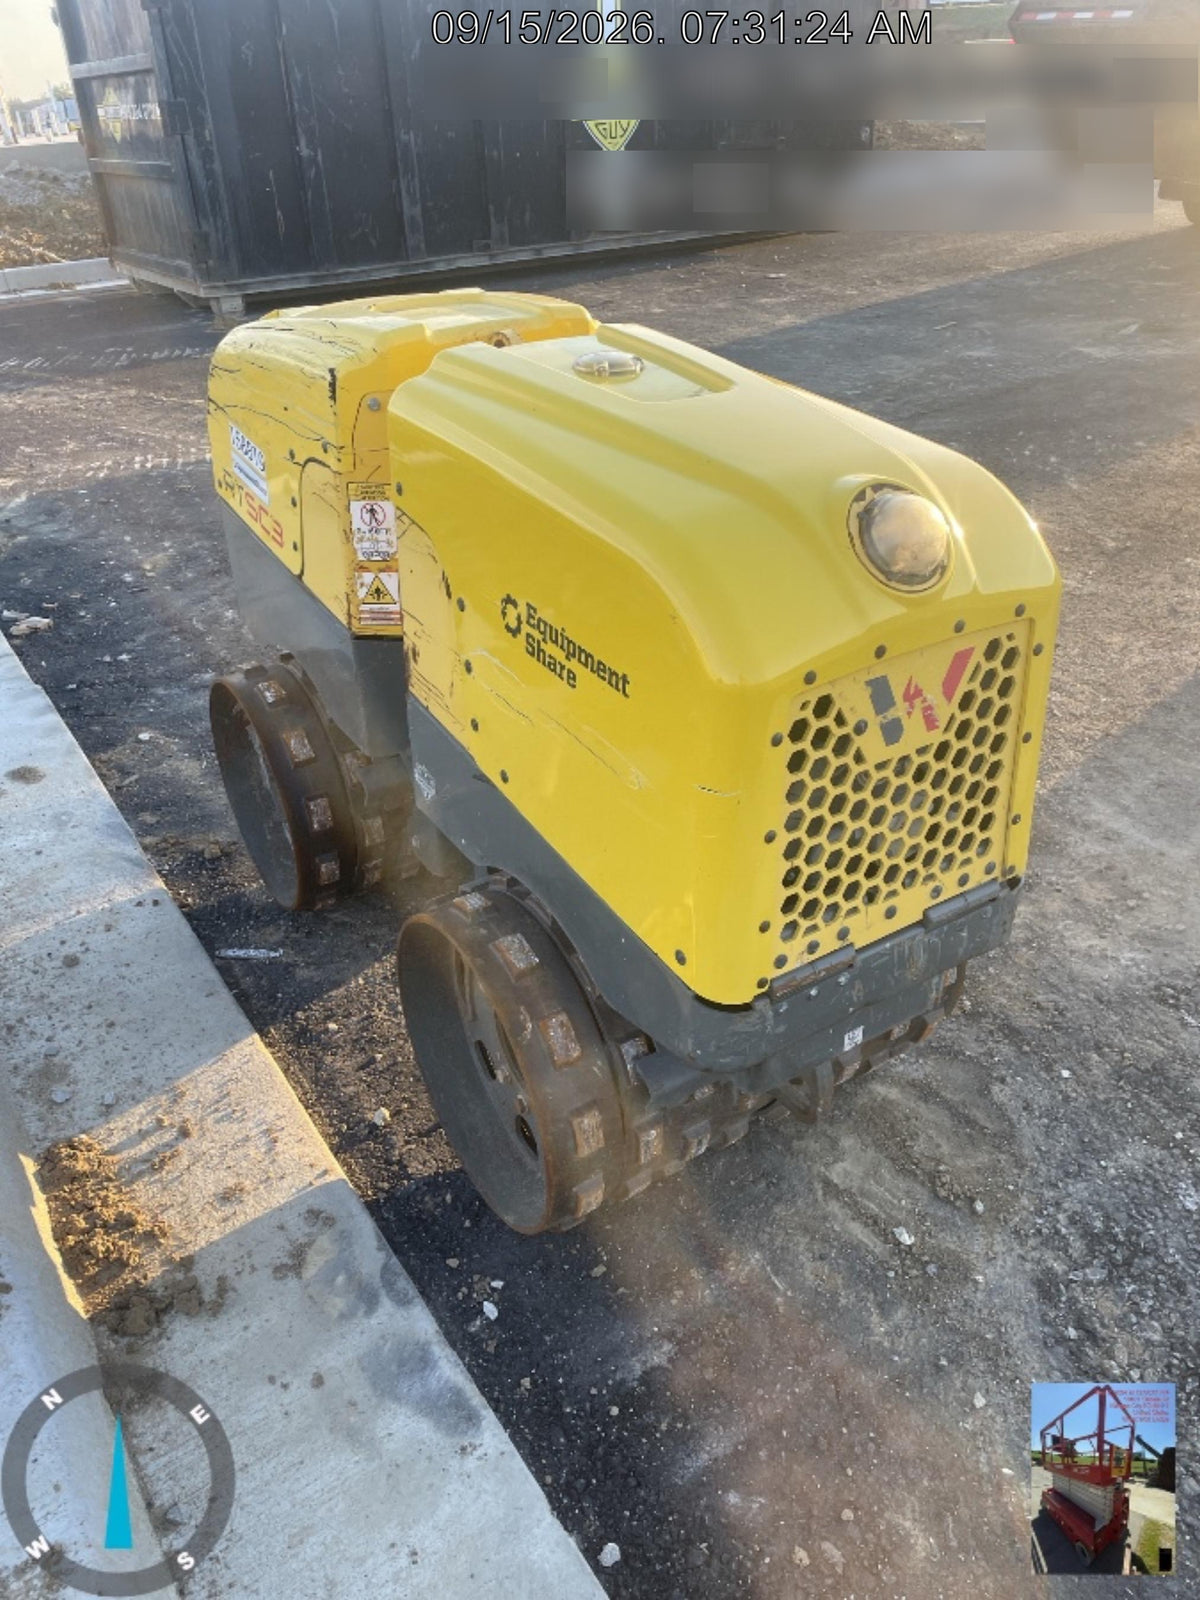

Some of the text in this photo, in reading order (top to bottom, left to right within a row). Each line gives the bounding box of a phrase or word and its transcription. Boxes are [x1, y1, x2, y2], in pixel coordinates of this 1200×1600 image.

[594, 119, 630, 139] GUY
[525, 601, 630, 699] Equipment
[525, 631, 577, 689] Share
